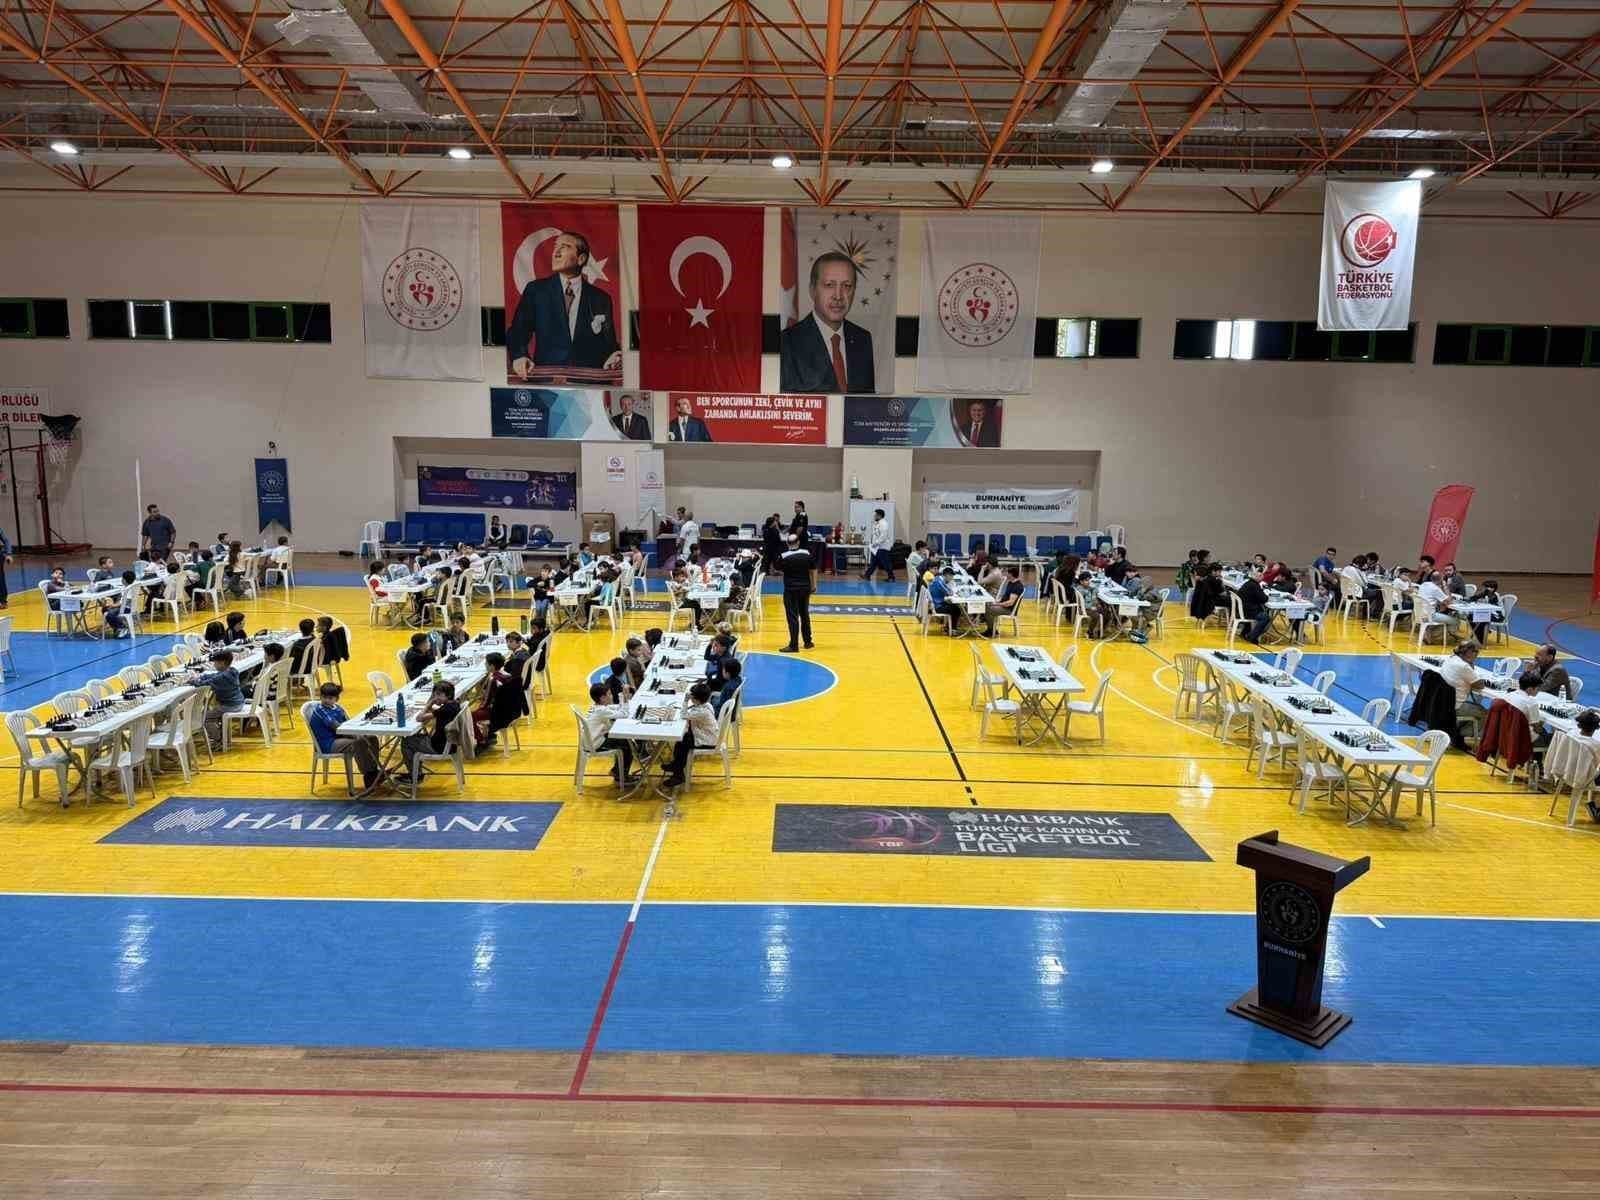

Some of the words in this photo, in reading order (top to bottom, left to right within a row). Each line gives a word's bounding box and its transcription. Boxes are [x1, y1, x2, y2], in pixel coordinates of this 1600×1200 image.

[1338, 269, 1394, 283] TÜRKİYE
[1337, 284, 1393, 292] BASKETBOL
[711, 396, 753, 407] SPORCUNUN
[774, 396, 794, 409] ÇEVİK
[795, 399, 804, 408] VE
[805, 399, 822, 408] AYNI
[704, 409, 738, 419] ZAMANDA
[975, 494, 1026, 502] BURHANİYE
[940, 503, 970, 511] GENÇLİK
[224, 812, 527, 833] HALKBANK
[981, 813, 1124, 826] HALKBANK
[953, 824, 1033, 833] TÜRKİYE
[1036, 826, 1133, 836] KADINLAR
[955, 832, 1141, 846] BASKETBOL
